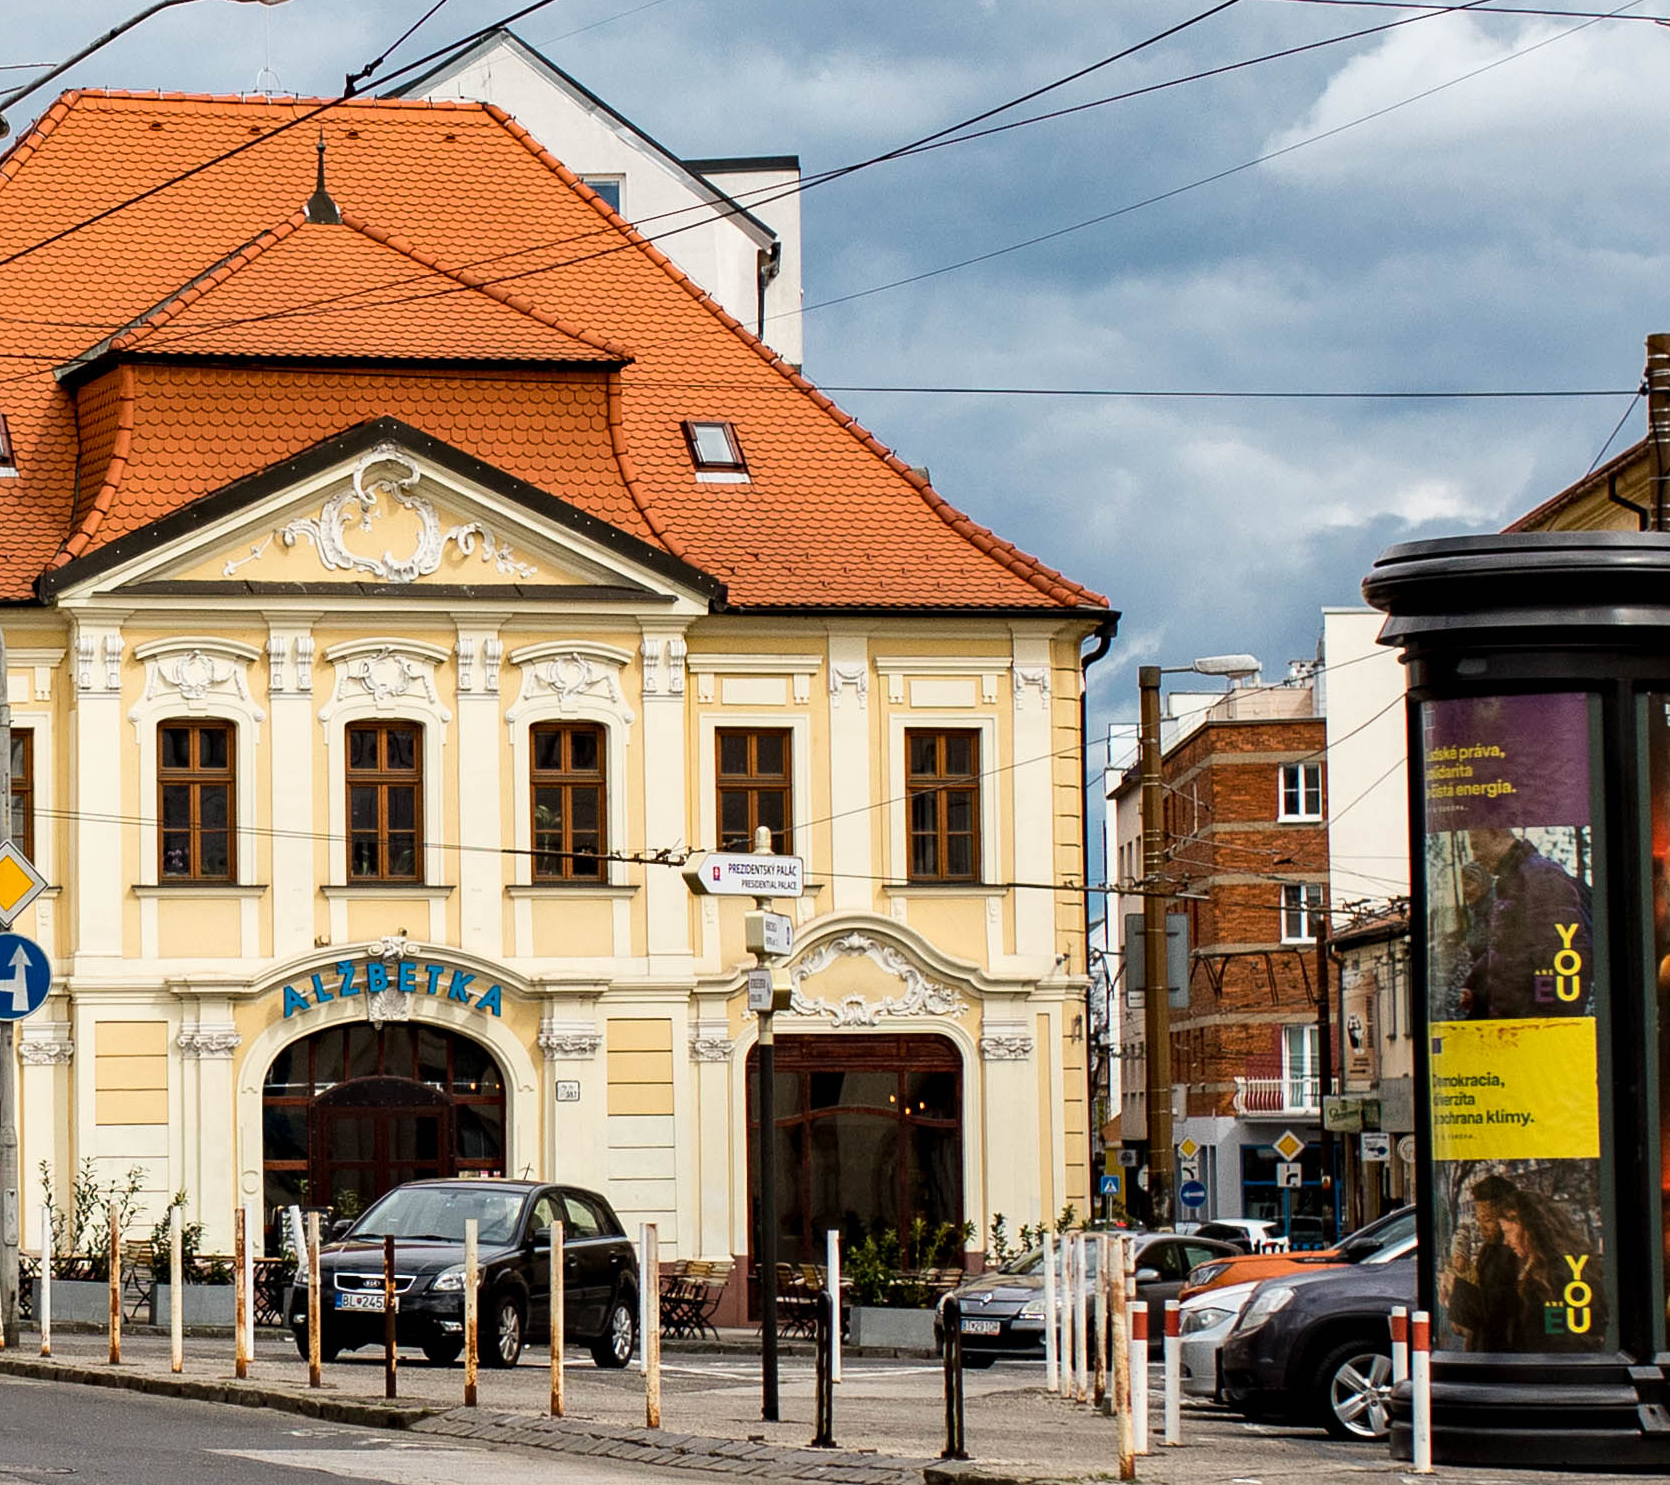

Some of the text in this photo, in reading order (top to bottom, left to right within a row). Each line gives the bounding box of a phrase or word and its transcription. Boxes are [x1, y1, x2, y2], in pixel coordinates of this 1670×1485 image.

[1459, 742, 1506, 762] práva,
[1456, 779, 1517, 798] energia.
[728, 862, 797, 877] PREZIDENTSKÝ PALÁC
[741, 879, 797, 890] PRESIDENTIAL PALACE
[1554, 923, 1582, 1002] YOU
[283, 959, 502, 1017] ALŽBETKA
[342, 1295, 356, 1307] BL
[1563, 1254, 1593, 1334] YOU
